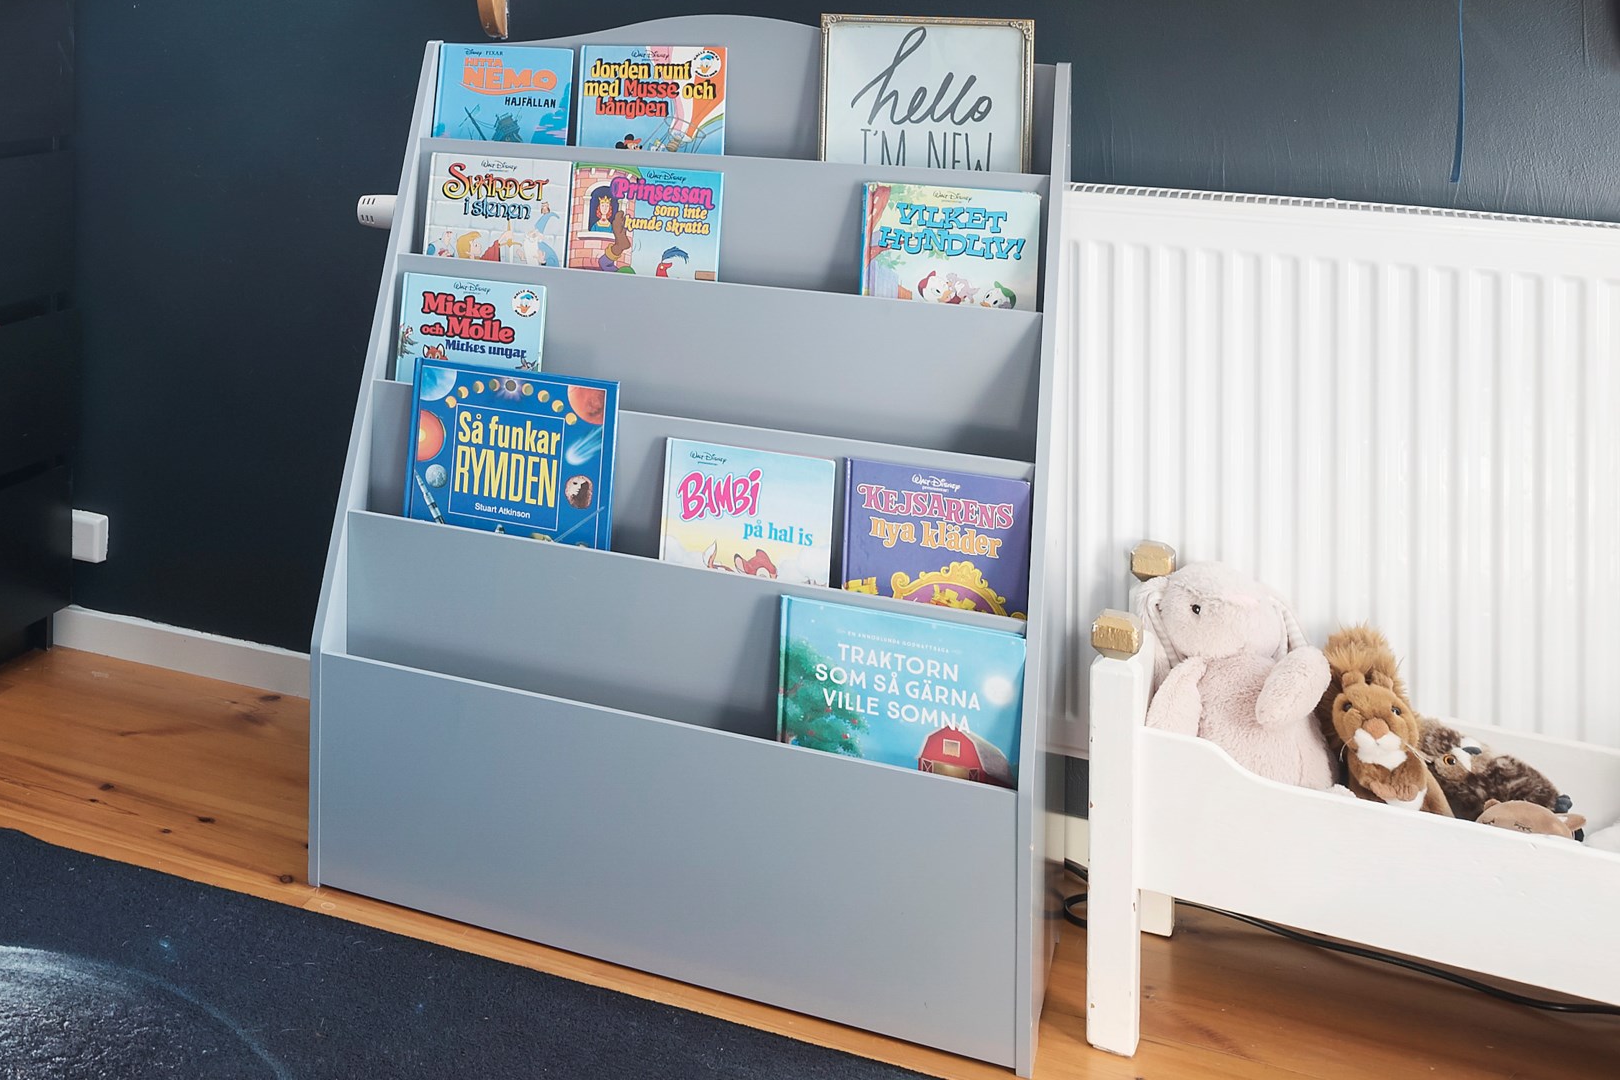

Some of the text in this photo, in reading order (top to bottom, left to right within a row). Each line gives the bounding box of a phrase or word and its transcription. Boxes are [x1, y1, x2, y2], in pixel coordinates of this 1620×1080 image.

[465, 57, 503, 67] HITTA
[591, 59, 692, 80] Jorden runt
[851, 26, 992, 126] hello
[463, 67, 557, 91] NEMO
[584, 78, 716, 100] med Musse och
[505, 96, 556, 108] HAJFÄLLAN
[595, 96, 669, 119] Långben
[928, 130, 992, 171] NEW
[611, 176, 715, 210] Prinsessan
[463, 197, 531, 220] i stenen
[654, 204, 708, 220] som inte
[896, 202, 1007, 233] VILKET
[624, 214, 710, 236] kunde skratta
[878, 225, 1026, 261] HUNDLIV!
[421, 291, 496, 319] Micke
[420, 316, 515, 344] och Molle
[445, 339, 527, 359] Mickes ungar
[458, 411, 561, 455] Så funkar
[454, 445, 558, 508] RYMDEN
[912, 473, 931, 486] Walt
[929, 476, 961, 492] Disney
[474, 502, 530, 519] Stuart Atkinson
[857, 483, 1014, 530] KEJSARENS
[743, 520, 813, 547] på hal is
[870, 517, 1002, 558] nya kläder
[838, 643, 959, 682] TRAKTORN
[815, 663, 981, 711] SOM SÅ GÄRNA
[822, 688, 971, 734] VILLE SOMNA
